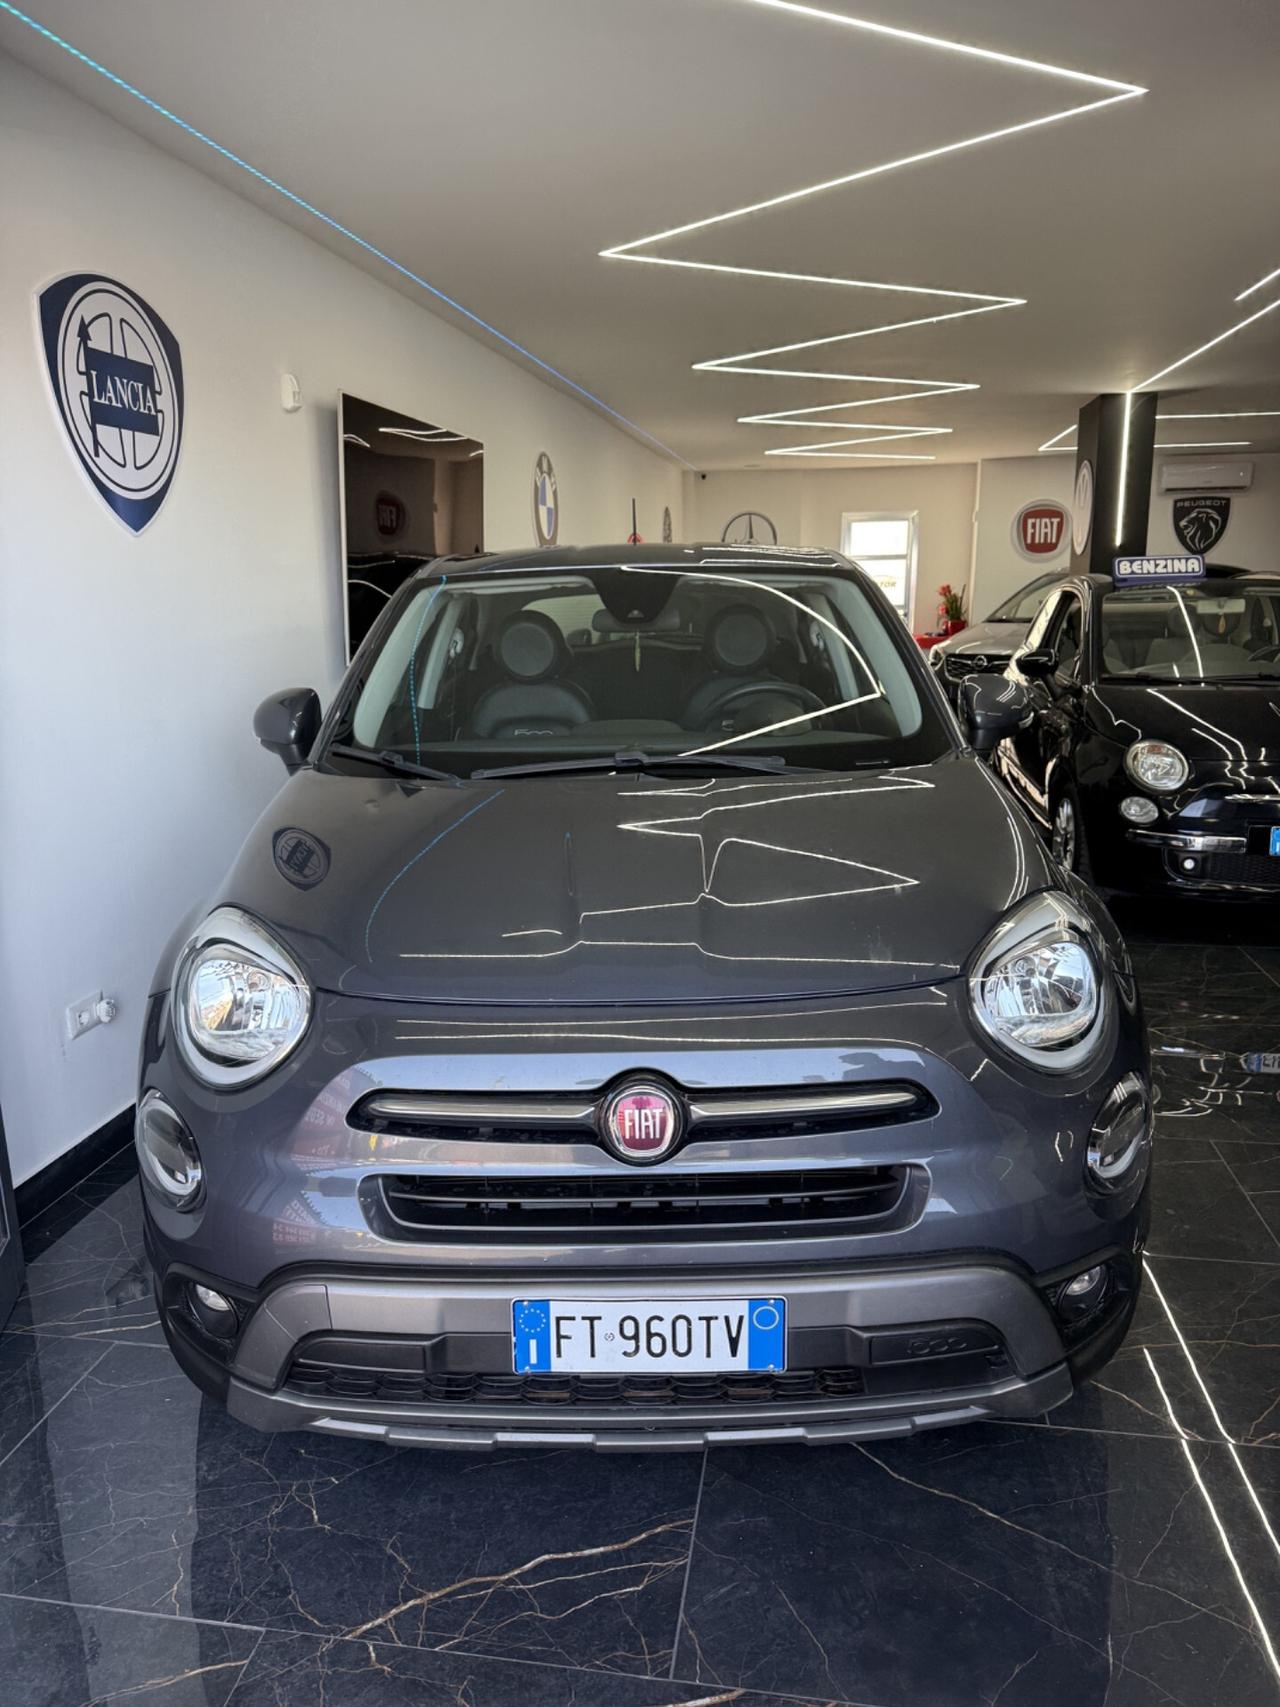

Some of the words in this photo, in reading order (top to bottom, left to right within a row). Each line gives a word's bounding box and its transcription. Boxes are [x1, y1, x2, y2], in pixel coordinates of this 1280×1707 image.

[90, 370, 157, 415] LANCIA
[1176, 499, 1227, 508] PEUGEOT
[1026, 517, 1060, 544] FIAT
[1119, 558, 1200, 575] BENZINA
[624, 1108, 663, 1139] FIAT
[555, 1316, 602, 1358] FT
[618, 1314, 745, 1358] 960TV
